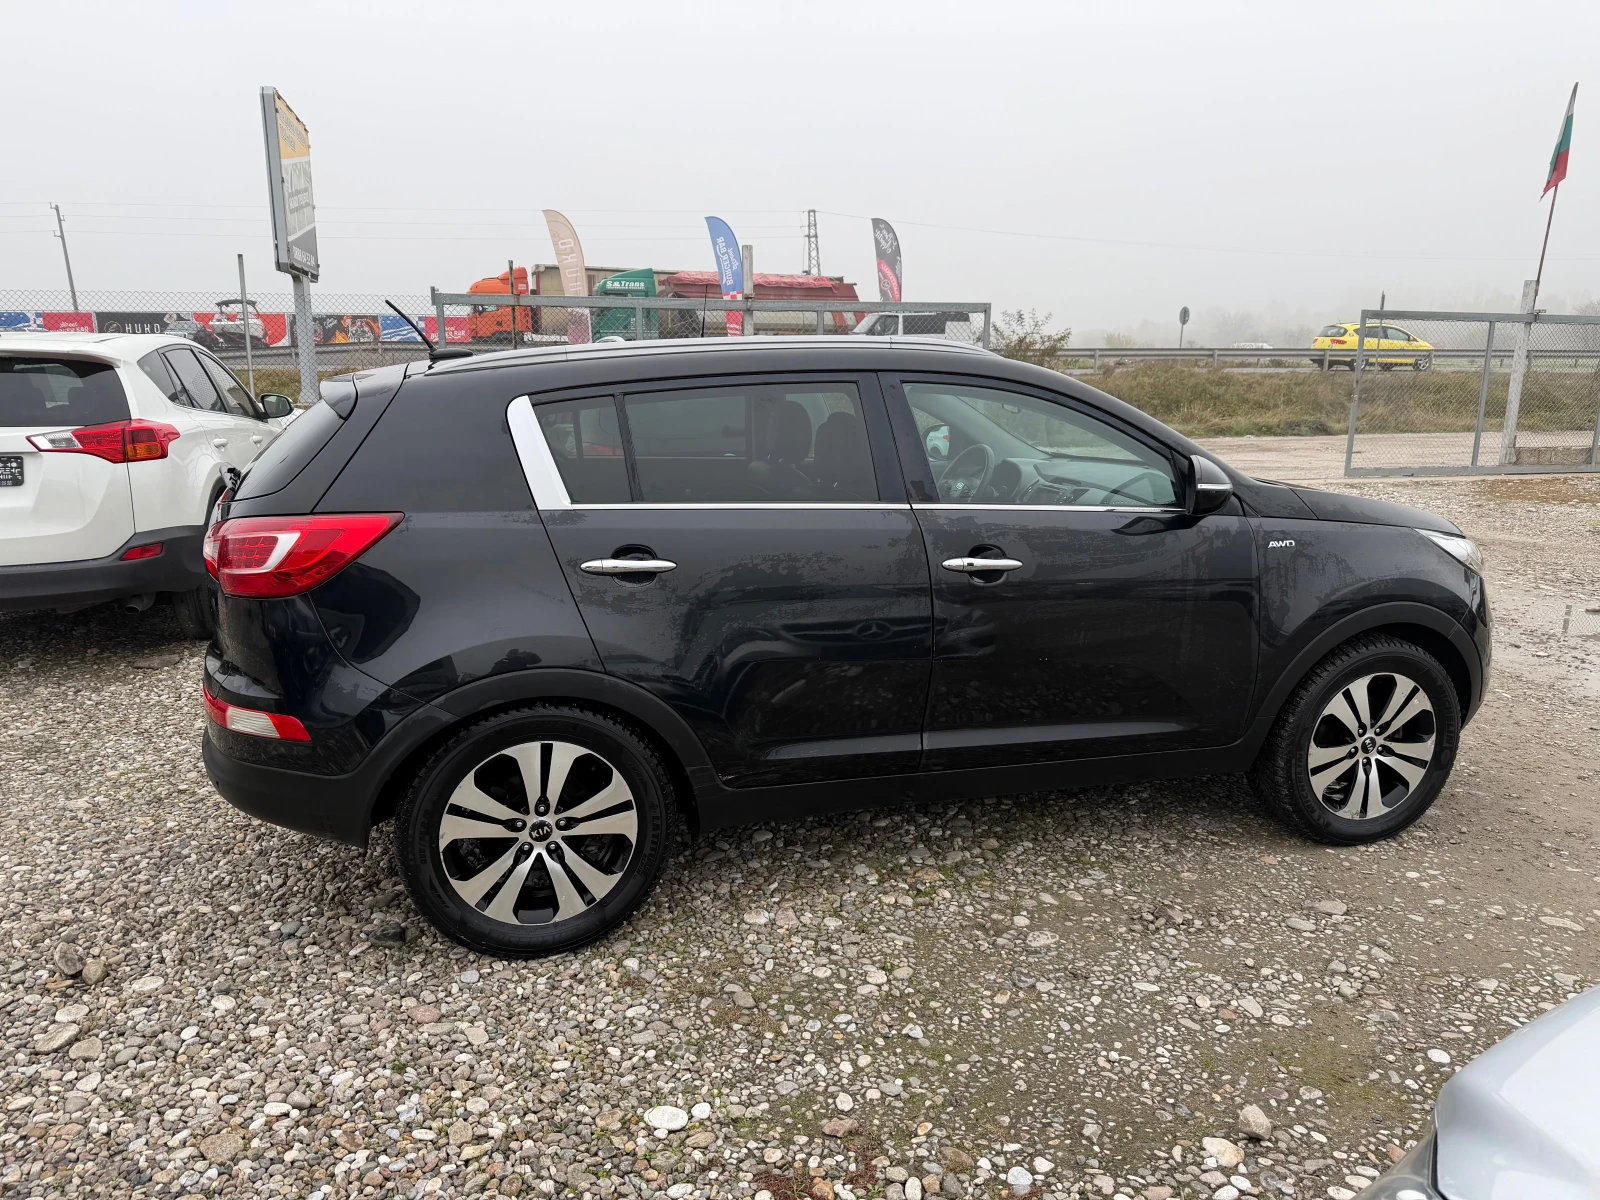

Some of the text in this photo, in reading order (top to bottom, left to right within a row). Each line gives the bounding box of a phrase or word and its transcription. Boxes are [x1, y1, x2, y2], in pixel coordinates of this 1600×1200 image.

[606, 280, 645, 288] S&Trans
[125, 323, 161, 334] HUKO
[1267, 539, 1296, 549] AWD
[530, 826, 551, 839] KIA
